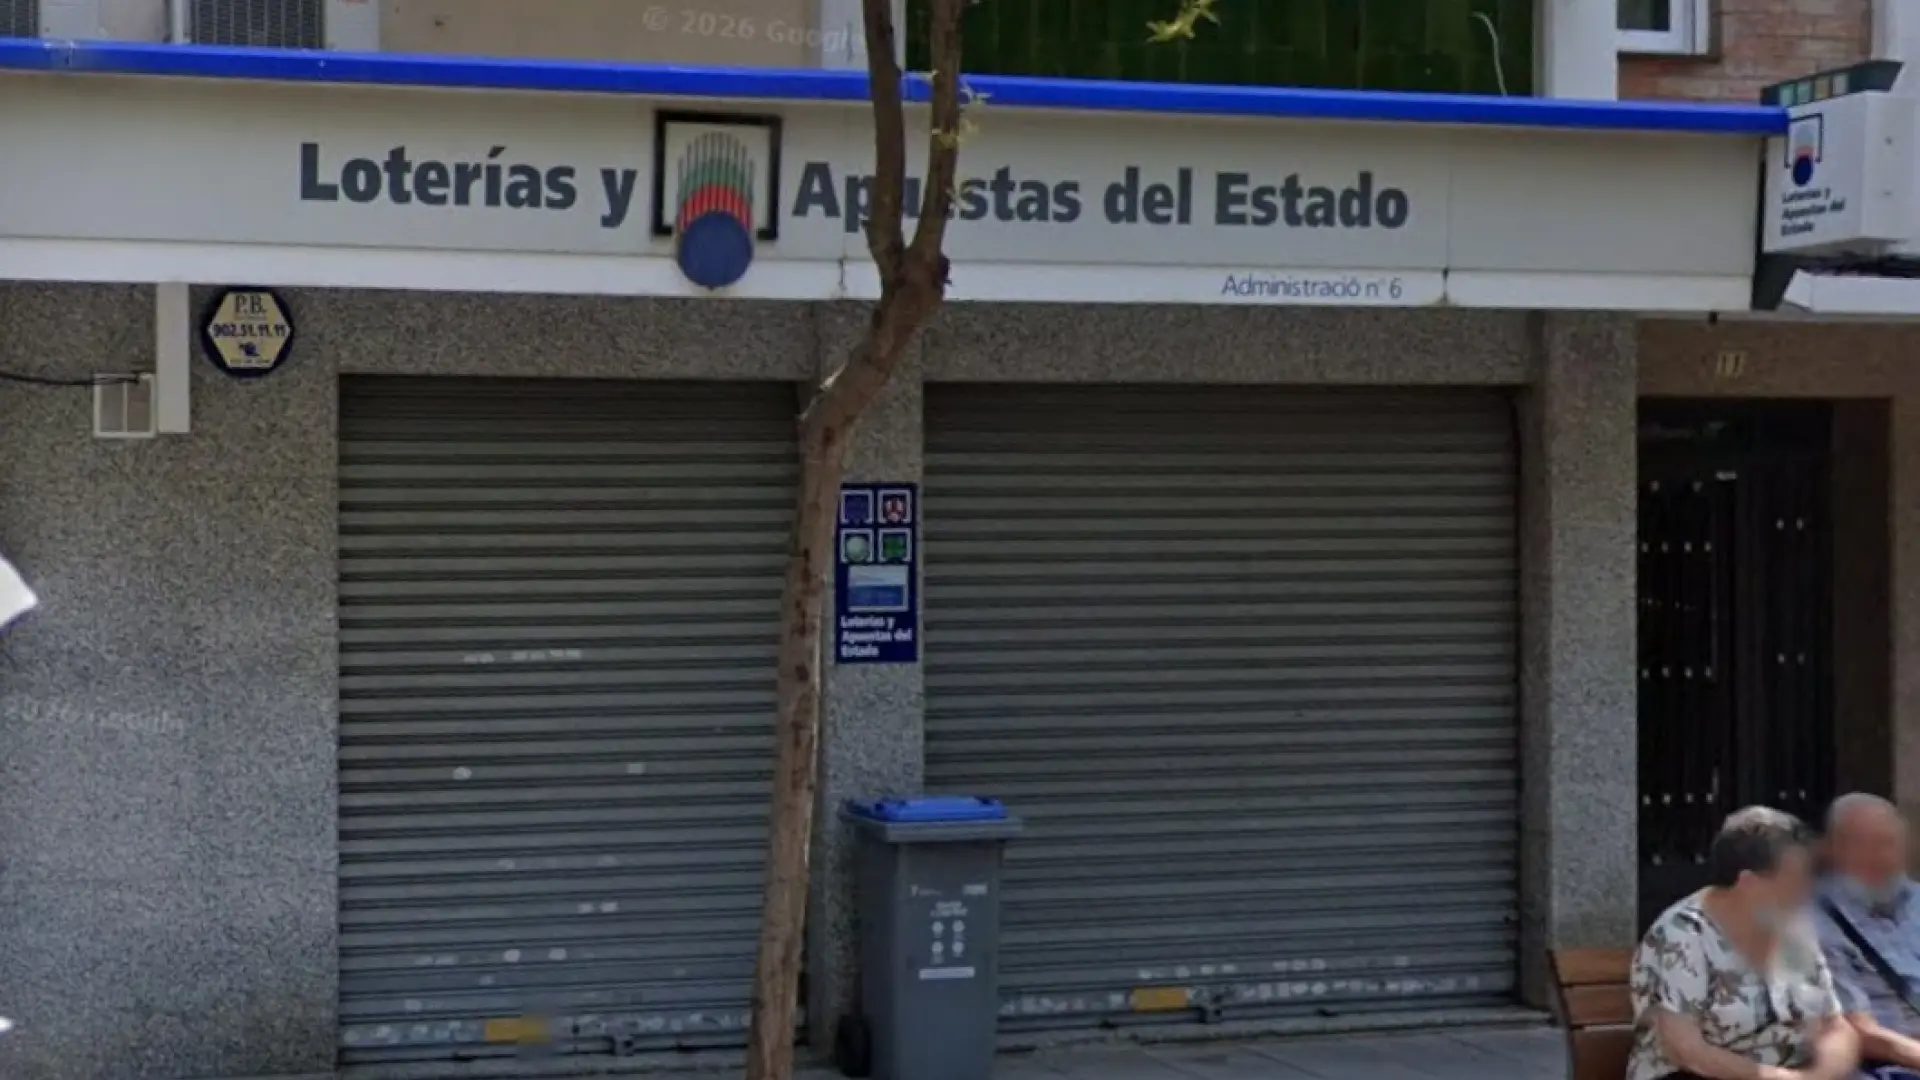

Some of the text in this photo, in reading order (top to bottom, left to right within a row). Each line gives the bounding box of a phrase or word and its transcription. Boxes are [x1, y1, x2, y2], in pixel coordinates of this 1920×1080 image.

[300, 141, 1409, 233] Loterías y Apstas del Estado
[1222, 274, 1361, 297] Administració
[1391, 278, 1403, 298] 6
